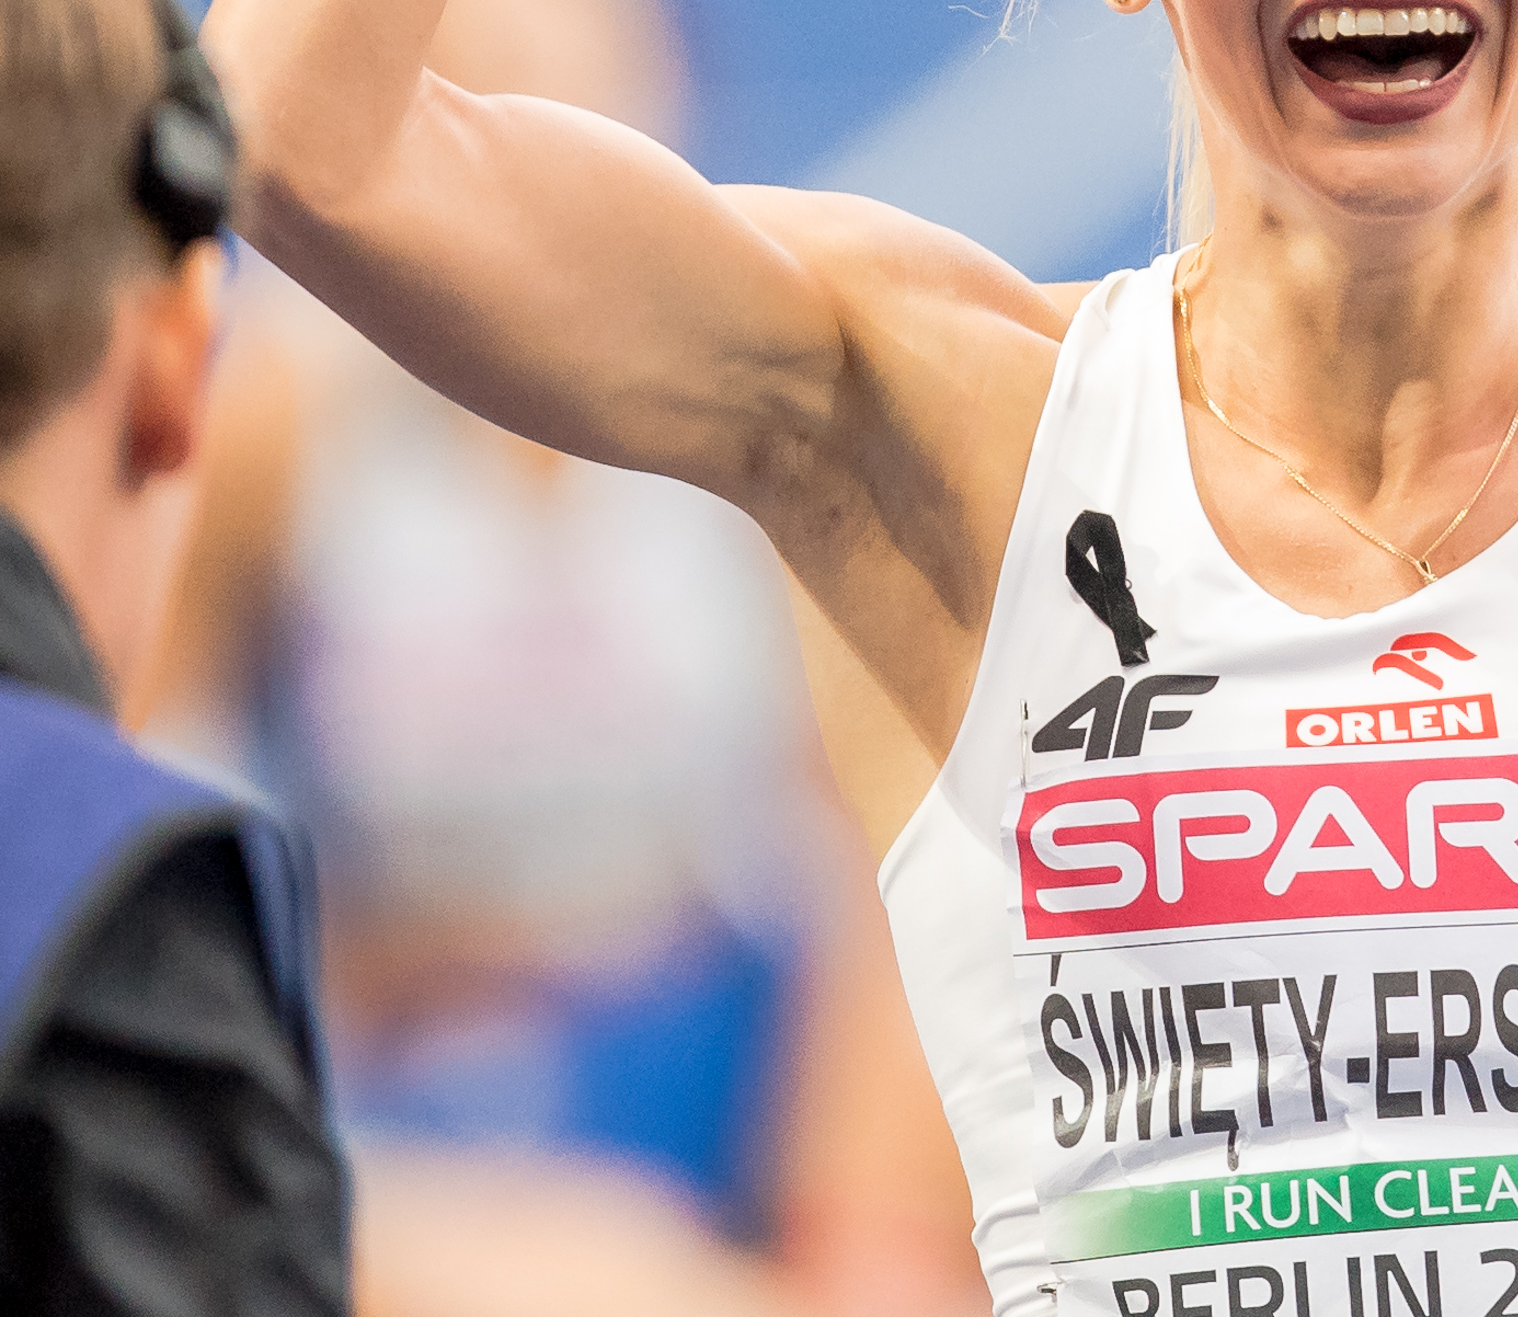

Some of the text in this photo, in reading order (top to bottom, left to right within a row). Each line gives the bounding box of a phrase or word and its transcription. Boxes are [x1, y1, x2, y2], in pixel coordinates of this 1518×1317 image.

[1031, 674, 1220, 761] 4F
[1296, 701, 1484, 747] ORLEN
[1190, 1190, 1202, 1236] I
[1224, 1176, 1352, 1232] RUN
